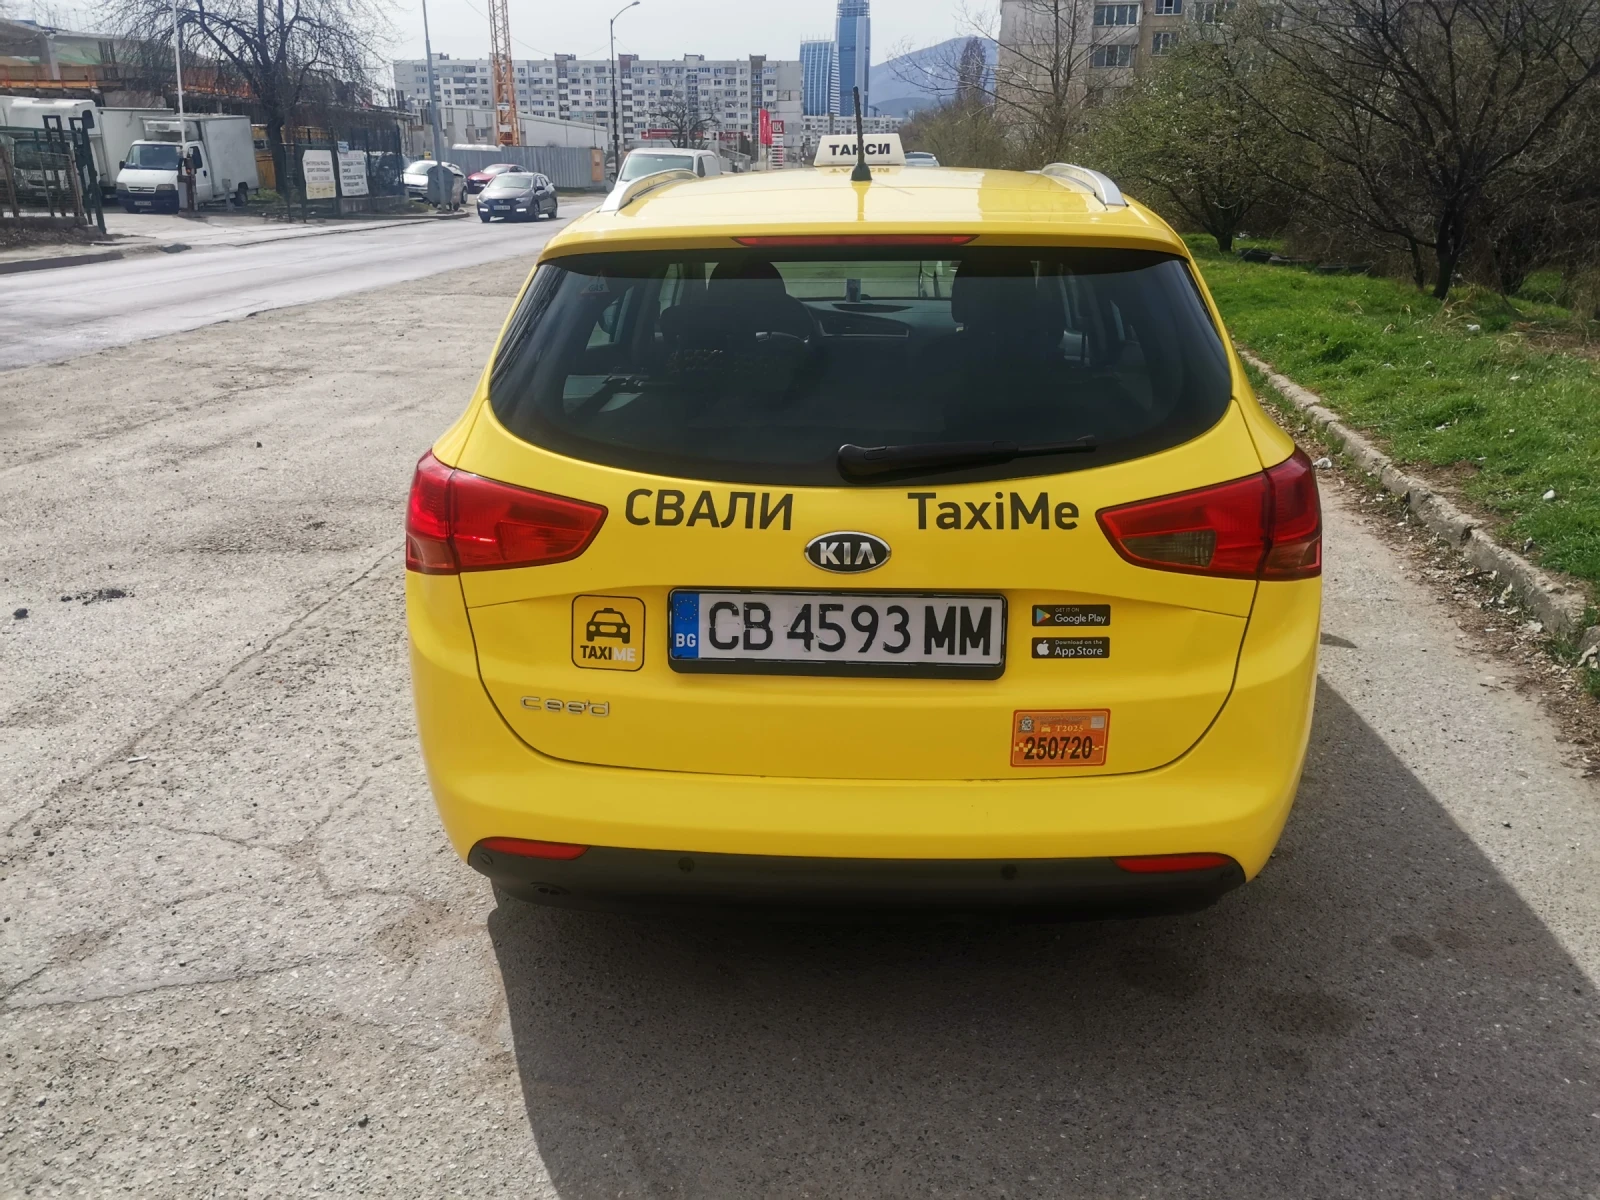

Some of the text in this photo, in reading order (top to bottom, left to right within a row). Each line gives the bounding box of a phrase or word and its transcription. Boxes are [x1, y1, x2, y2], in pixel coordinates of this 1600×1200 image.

[624, 488, 794, 531] СВАЛИ
[907, 492, 1080, 531] TaxiMe
[818, 541, 878, 566] KIA
[708, 601, 993, 656] CB 4593 MM
[1054, 613, 1107, 625] Google Play
[675, 633, 697, 648] BG
[1054, 646, 1103, 657] App Store
[1055, 724, 1084, 732] T2025
[1023, 735, 1093, 760] 250720
